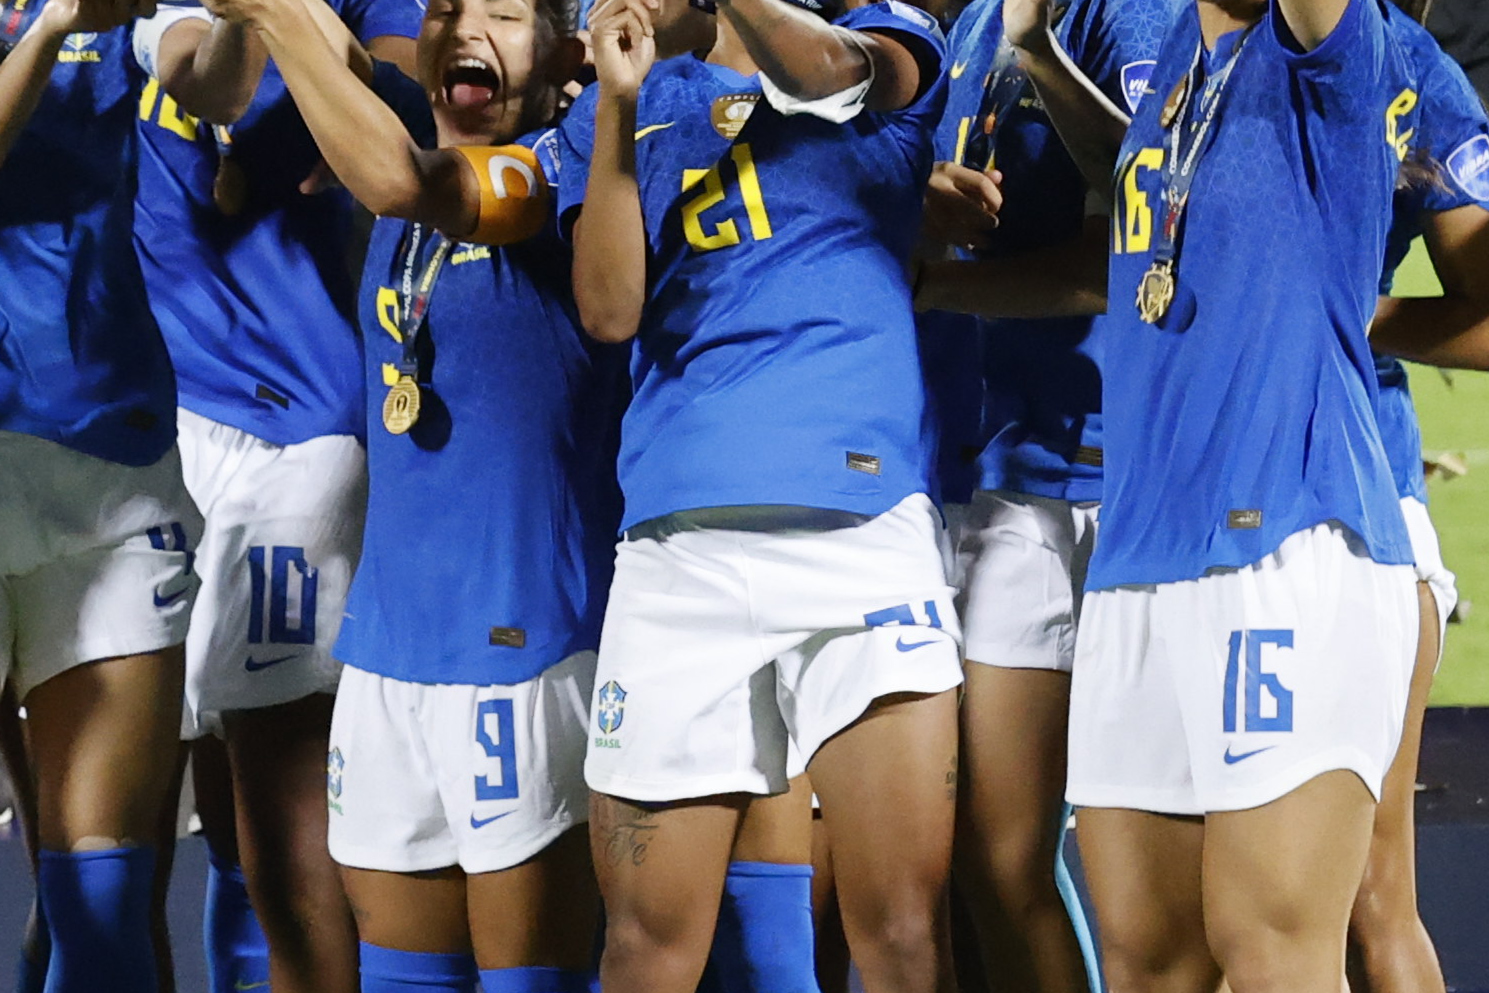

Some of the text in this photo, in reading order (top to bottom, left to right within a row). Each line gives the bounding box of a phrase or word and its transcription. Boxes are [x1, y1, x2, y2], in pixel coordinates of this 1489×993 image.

[57, 50, 101, 63] BRASIL
[681, 142, 773, 252] 21
[451, 246, 492, 266] BRASIL
[247, 545, 319, 645] 10
[1222, 629, 1294, 733] 16
[475, 698, 520, 801] 9
[594, 737, 622, 749] BRASIL
